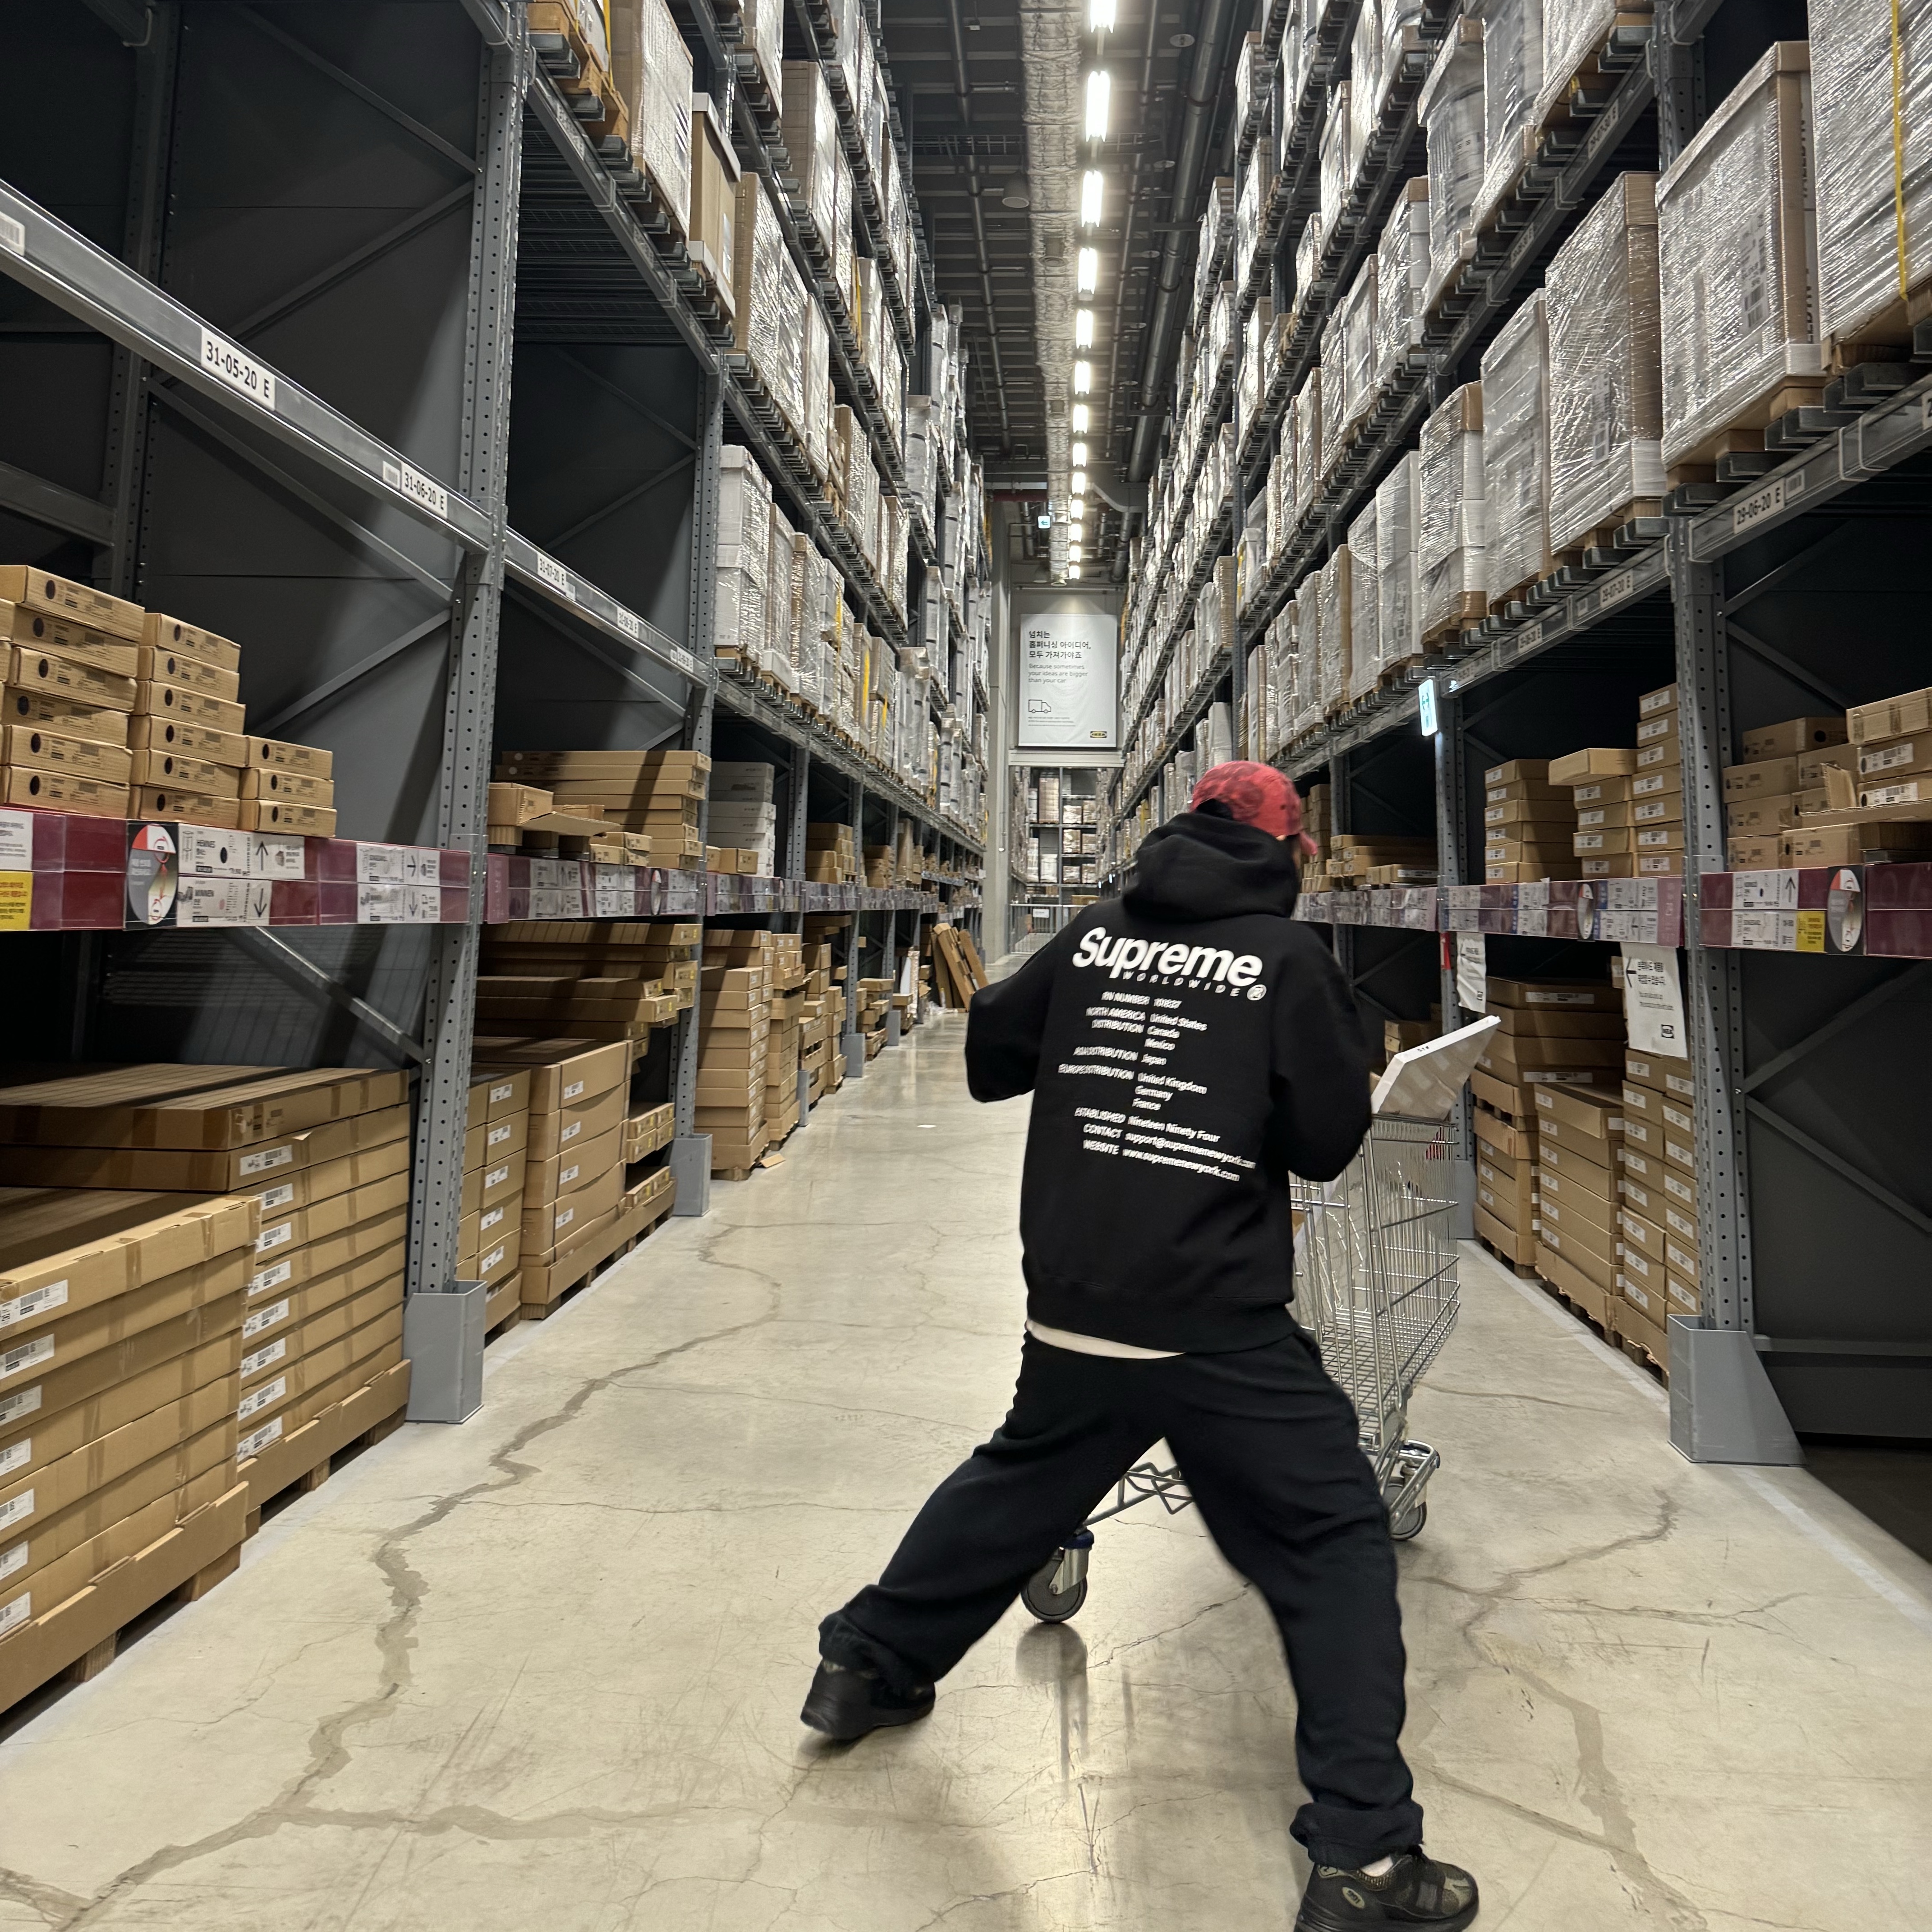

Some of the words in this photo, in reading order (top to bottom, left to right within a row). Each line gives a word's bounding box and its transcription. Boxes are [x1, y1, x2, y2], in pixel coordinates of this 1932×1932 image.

[207, 341, 257, 390] 31-05-20
[264, 378, 269, 398] E
[405, 472, 436, 505] 31-06-20
[440, 495, 444, 510] E
[1775, 487, 1780, 503] E
[562, 574, 564, 585] E
[1072, 927, 1263, 987] Supreme
[1123, 971, 1241, 997] WORLDWIDE
[1150, 1013, 1179, 1025] United
[1177, 1017, 1207, 1031] States
[1147, 1026, 1180, 1039] Canada
[1144, 1038, 1176, 1050] Mexico
[1141, 1053, 1167, 1066] Japan
[1138, 1072, 1166, 1085] United
[1165, 1077, 1207, 1094] Kingdom
[1135, 1085, 1173, 1101] Germany
[1132, 1098, 1161, 1111] France
[1074, 1107, 1126, 1123] ESTABLISHED
[1128, 1116, 1165, 1131] Nineteen
[1165, 1123, 1197, 1139] Ninety
[1197, 1130, 1220, 1142] Four
[1084, 1123, 1123, 1138] CONTACT
[1084, 1139, 1120, 1155] WEBSITE
